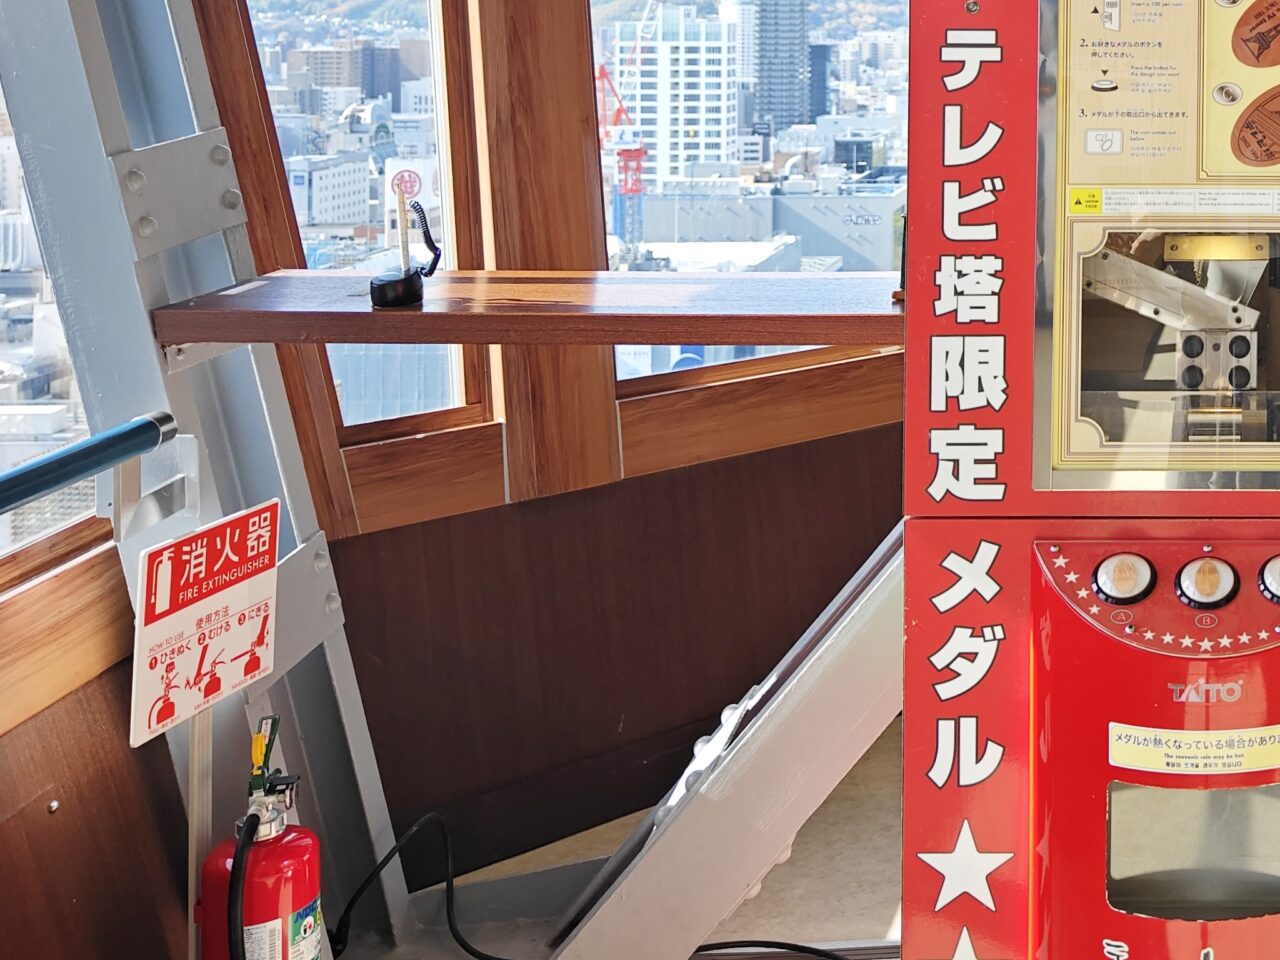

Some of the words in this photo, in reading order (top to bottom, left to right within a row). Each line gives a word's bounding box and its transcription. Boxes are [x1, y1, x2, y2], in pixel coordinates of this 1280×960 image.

[1080, 38, 1089, 48] 2.
[1222, 87, 1233, 101] C
[1079, 109, 1088, 118] 3.
[181, 511, 271, 586] 消火器
[179, 585, 199, 604] FIRE
[202, 555, 270, 593] EXTINGUISHER
[195, 605, 230, 631] 使用方法
[248, 602, 270, 620] にぎる
[1118, 611, 1128, 621] A
[208, 621, 231, 640] むける
[1202, 616, 1211, 626] B
[149, 641, 164, 653] HOW
[166, 636, 173, 646] TO
[174, 631, 184, 642] USE
[160, 640, 192, 664] ひきぬく
[1167, 677, 1244, 703] TAITO
